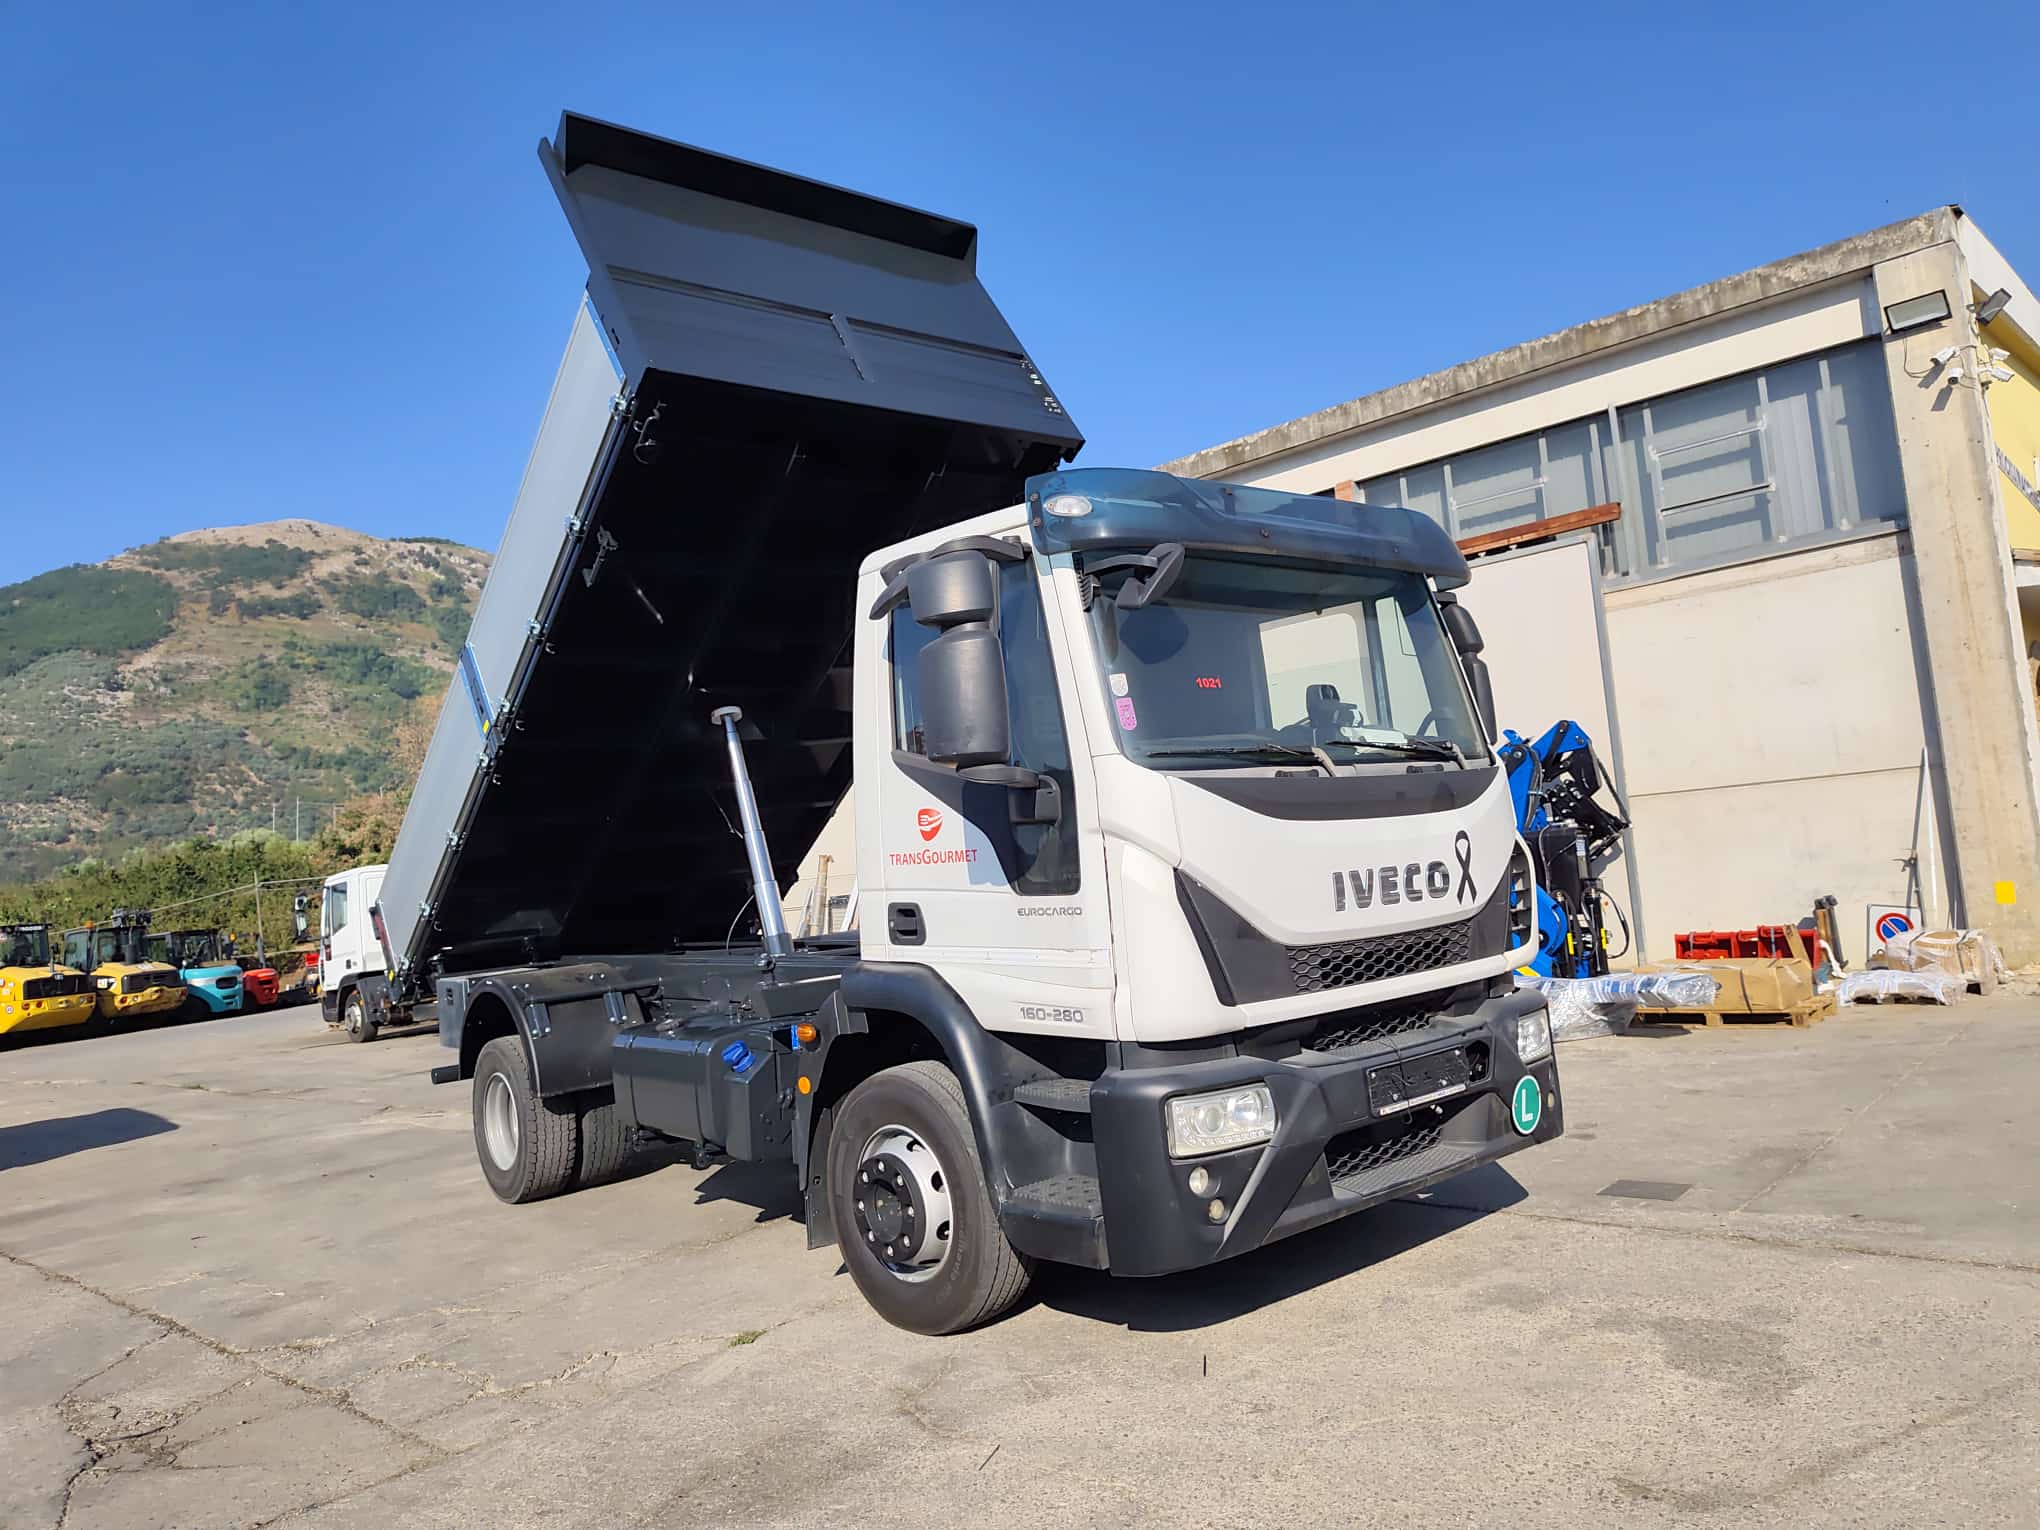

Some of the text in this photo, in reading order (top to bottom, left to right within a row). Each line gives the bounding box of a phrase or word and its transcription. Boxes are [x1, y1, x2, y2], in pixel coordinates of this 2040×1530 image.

[1196, 677, 1222, 688] 1021
[889, 849, 977, 865] TRANSGOURMET
[1332, 860, 1450, 912] IVECO
[1017, 907, 1082, 916] EUROCARGO
[1020, 1007, 1083, 1022] 160-280
[1521, 1088, 1534, 1122] L
